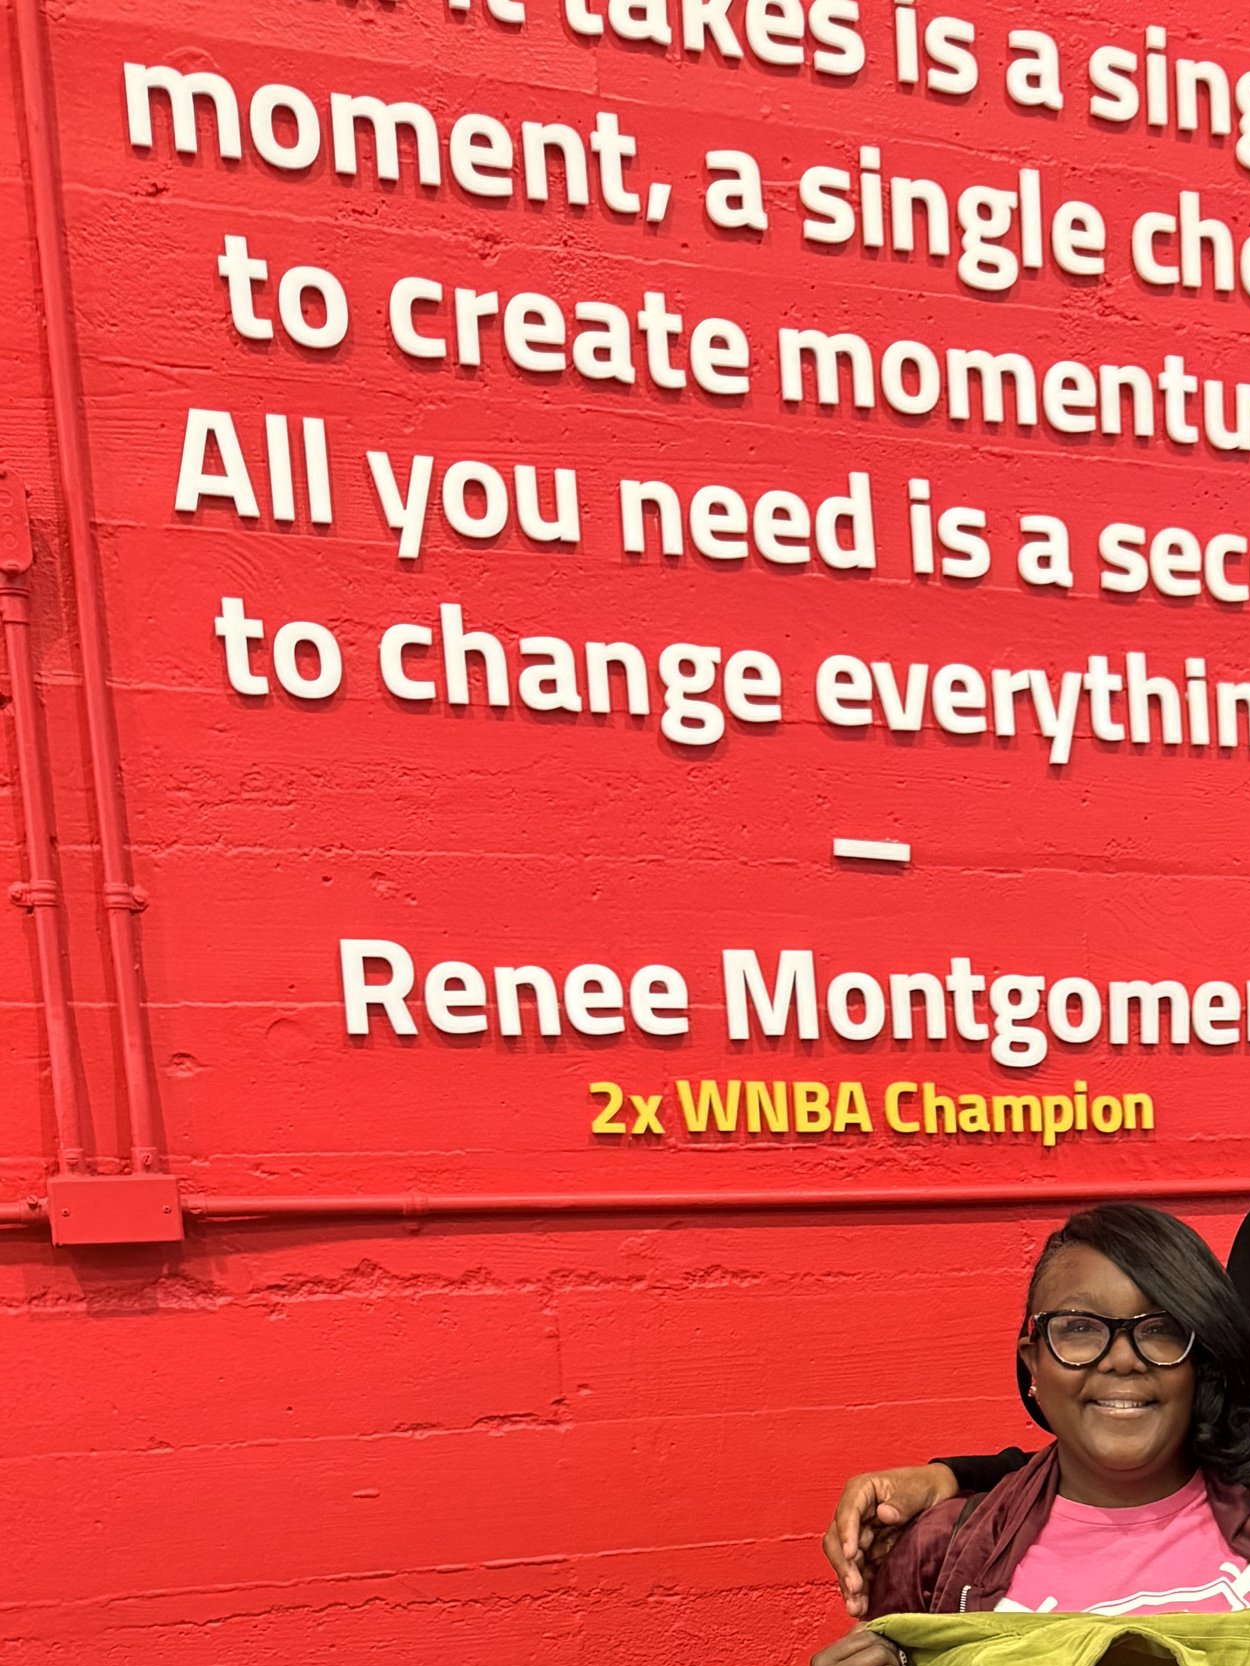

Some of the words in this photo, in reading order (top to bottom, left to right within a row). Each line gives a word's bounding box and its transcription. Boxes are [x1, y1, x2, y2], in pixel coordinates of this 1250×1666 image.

[896, 0, 977, 95] is
[1006, 30, 1063, 110] a
[123, 62, 671, 222] moment,
[705, 149, 768, 230] a
[799, 146, 1106, 290] single
[218, 235, 349, 348] to
[389, 276, 750, 394] create
[174, 407, 333, 524] All
[366, 450, 581, 559] you
[620, 471, 876, 569] need
[909, 478, 991, 578] is
[1017, 514, 1074, 588] a
[215, 597, 343, 700] to
[378, 602, 782, 745] change
[339, 938, 689, 1037] Renee
[589, 1081, 665, 1134] 2x
[676, 1079, 873, 1133] WNBA
[885, 1081, 1154, 1146] Champion
